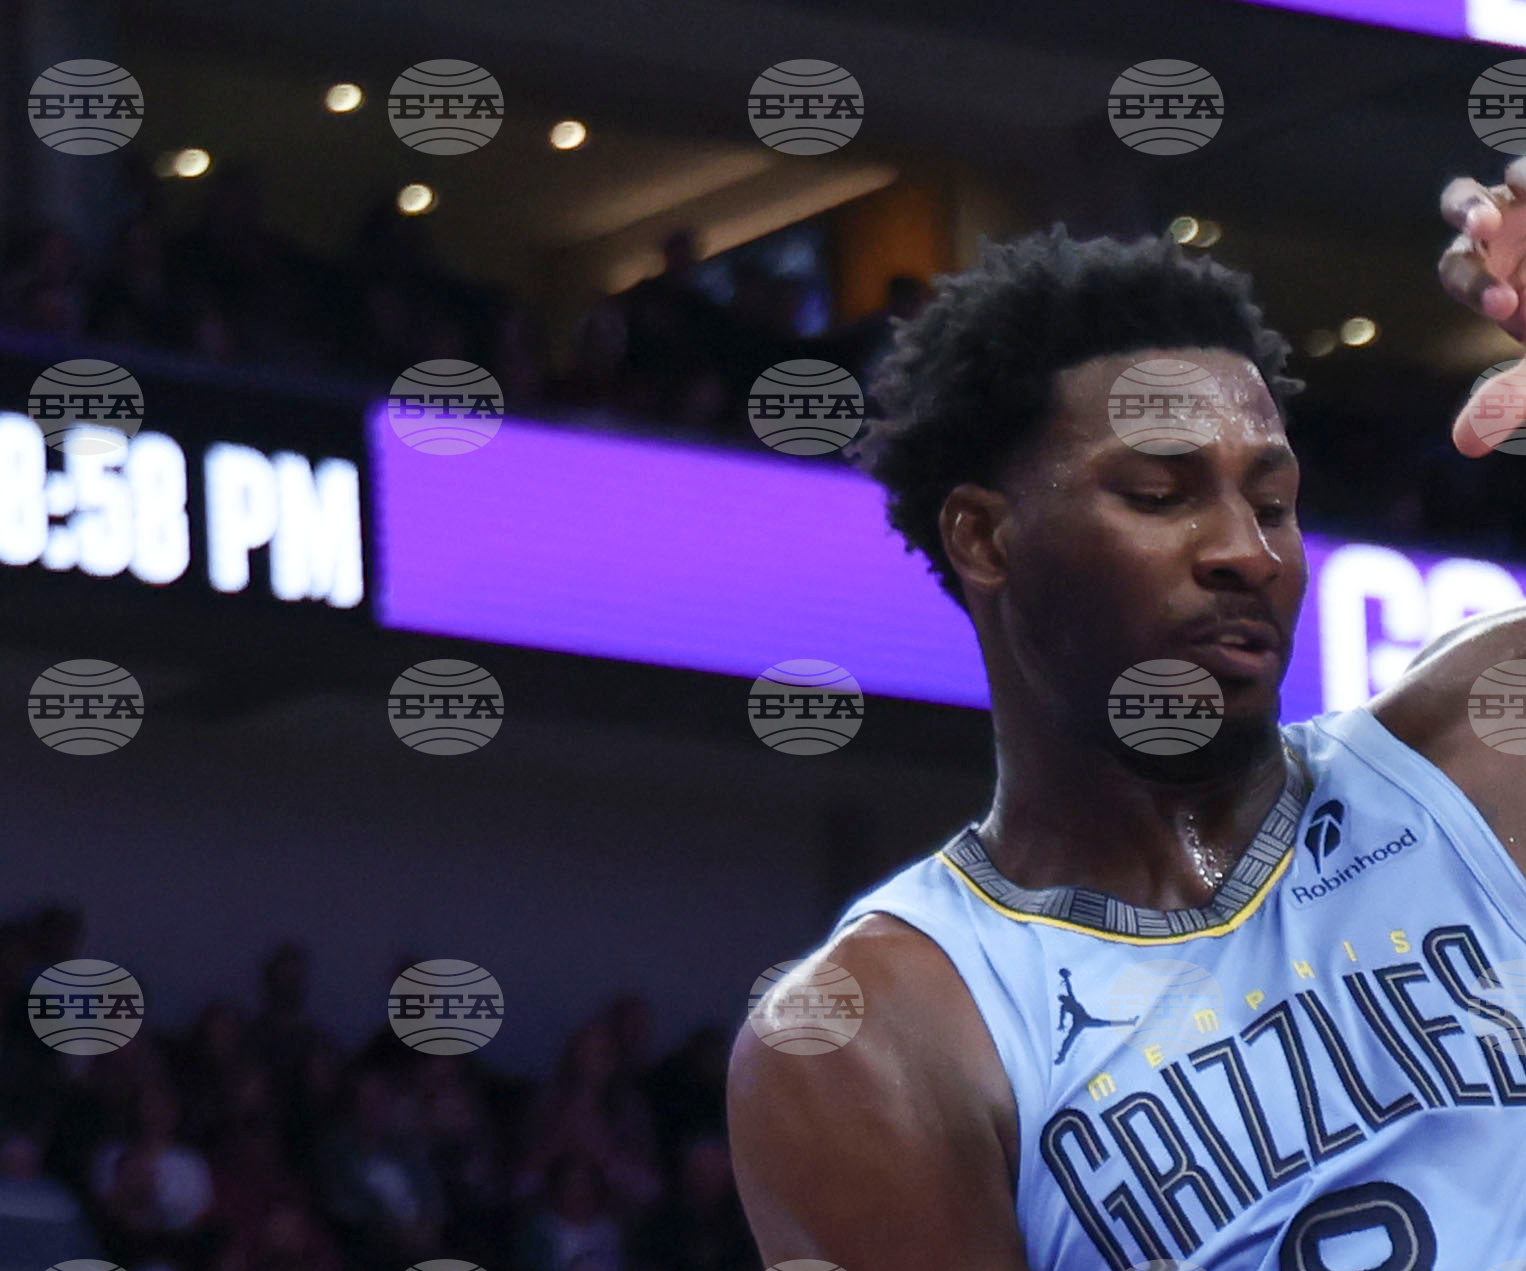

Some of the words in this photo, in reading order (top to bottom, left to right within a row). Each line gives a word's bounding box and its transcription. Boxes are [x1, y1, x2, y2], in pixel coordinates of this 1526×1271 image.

[205, 441, 365, 609] PM
[1291, 828, 1417, 904] Robinhood
[1087, 930, 1411, 1102] MEMPHIS
